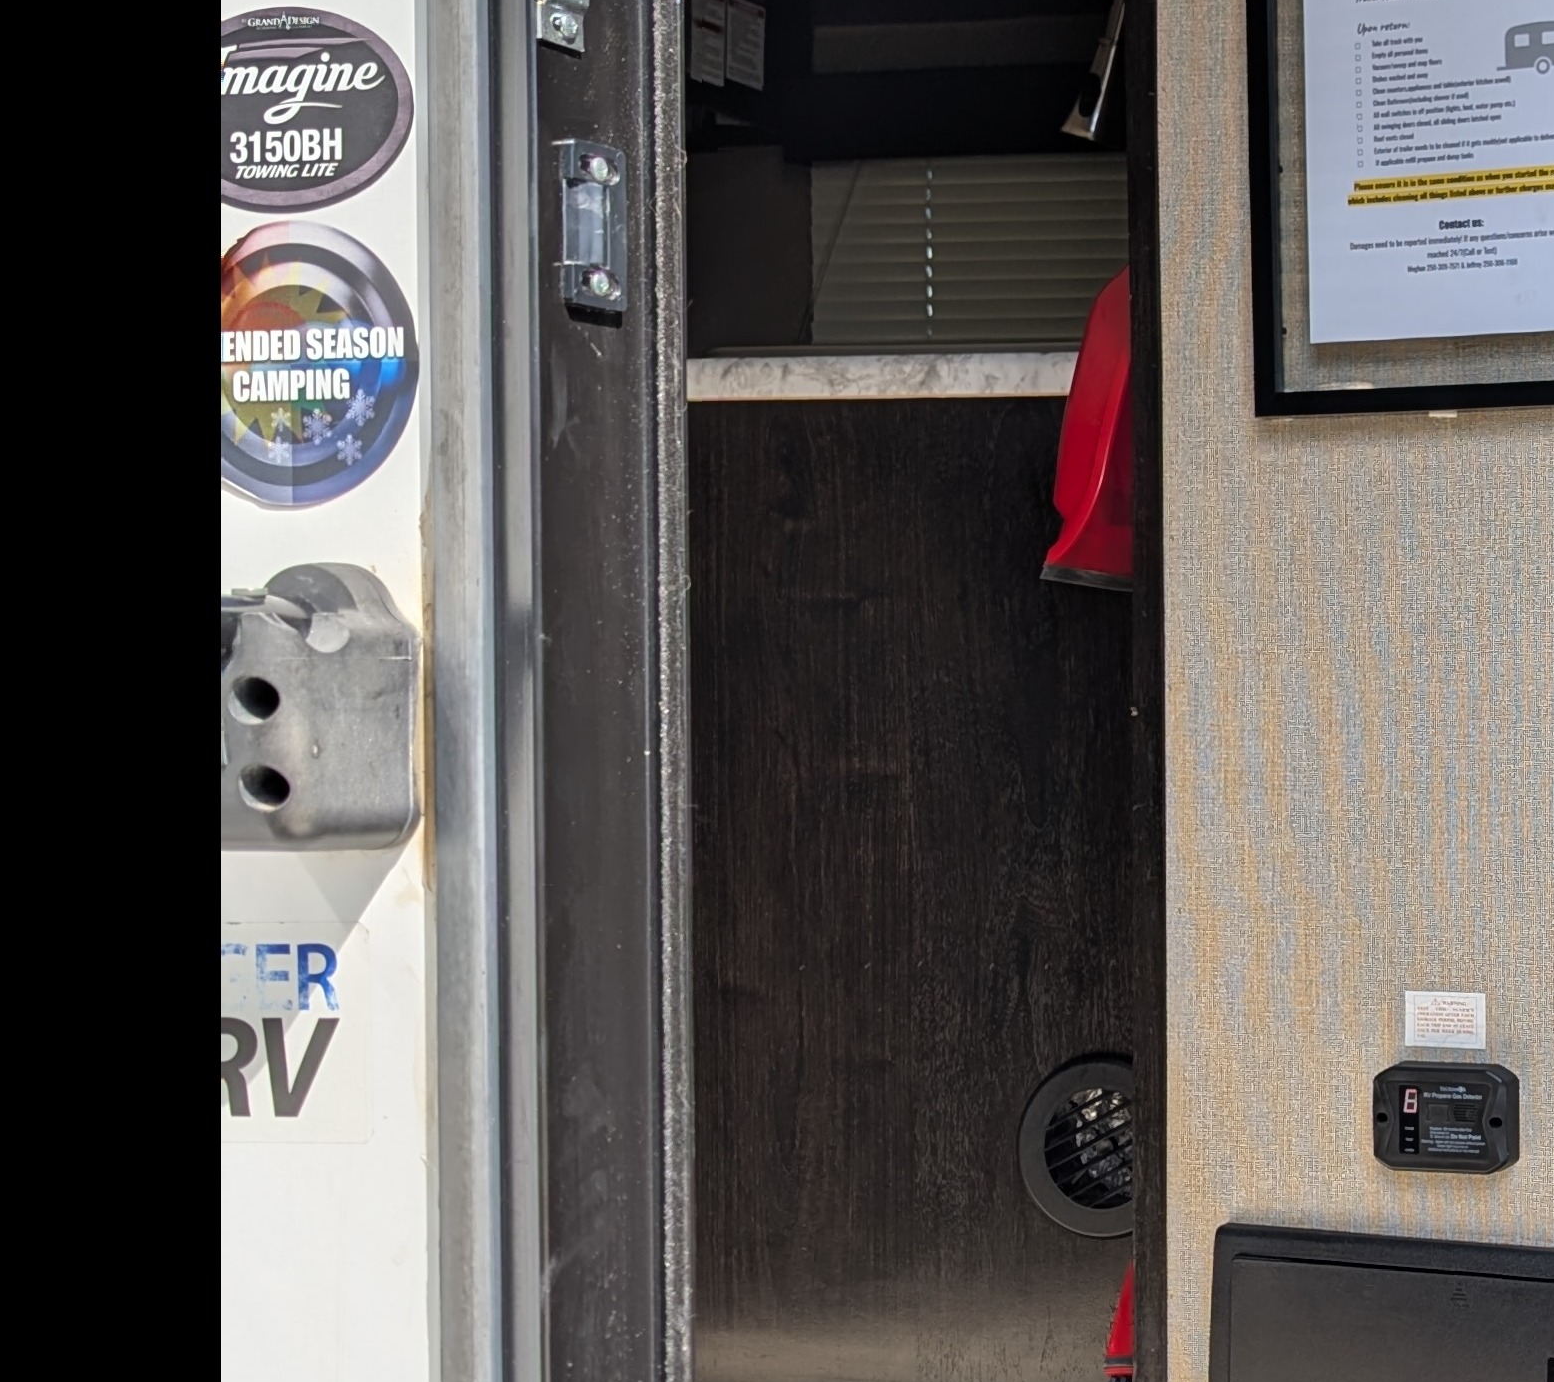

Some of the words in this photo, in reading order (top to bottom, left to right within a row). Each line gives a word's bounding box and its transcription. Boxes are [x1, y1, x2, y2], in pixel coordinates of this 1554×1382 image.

[248, 18, 280, 27] GRAND
[288, 16, 320, 25] DESIGN
[1357, 23, 1378, 36] Upon
[230, 128, 342, 164] 3150BH
[235, 164, 299, 180] TOWING
[301, 163, 338, 178] LITE
[1439, 219, 1470, 230] Contact
[1472, 219, 1484, 228] us:
[306, 327, 404, 361] SEASON
[232, 368, 350, 403] CAMPING
[221, 1017, 340, 1118] RV
